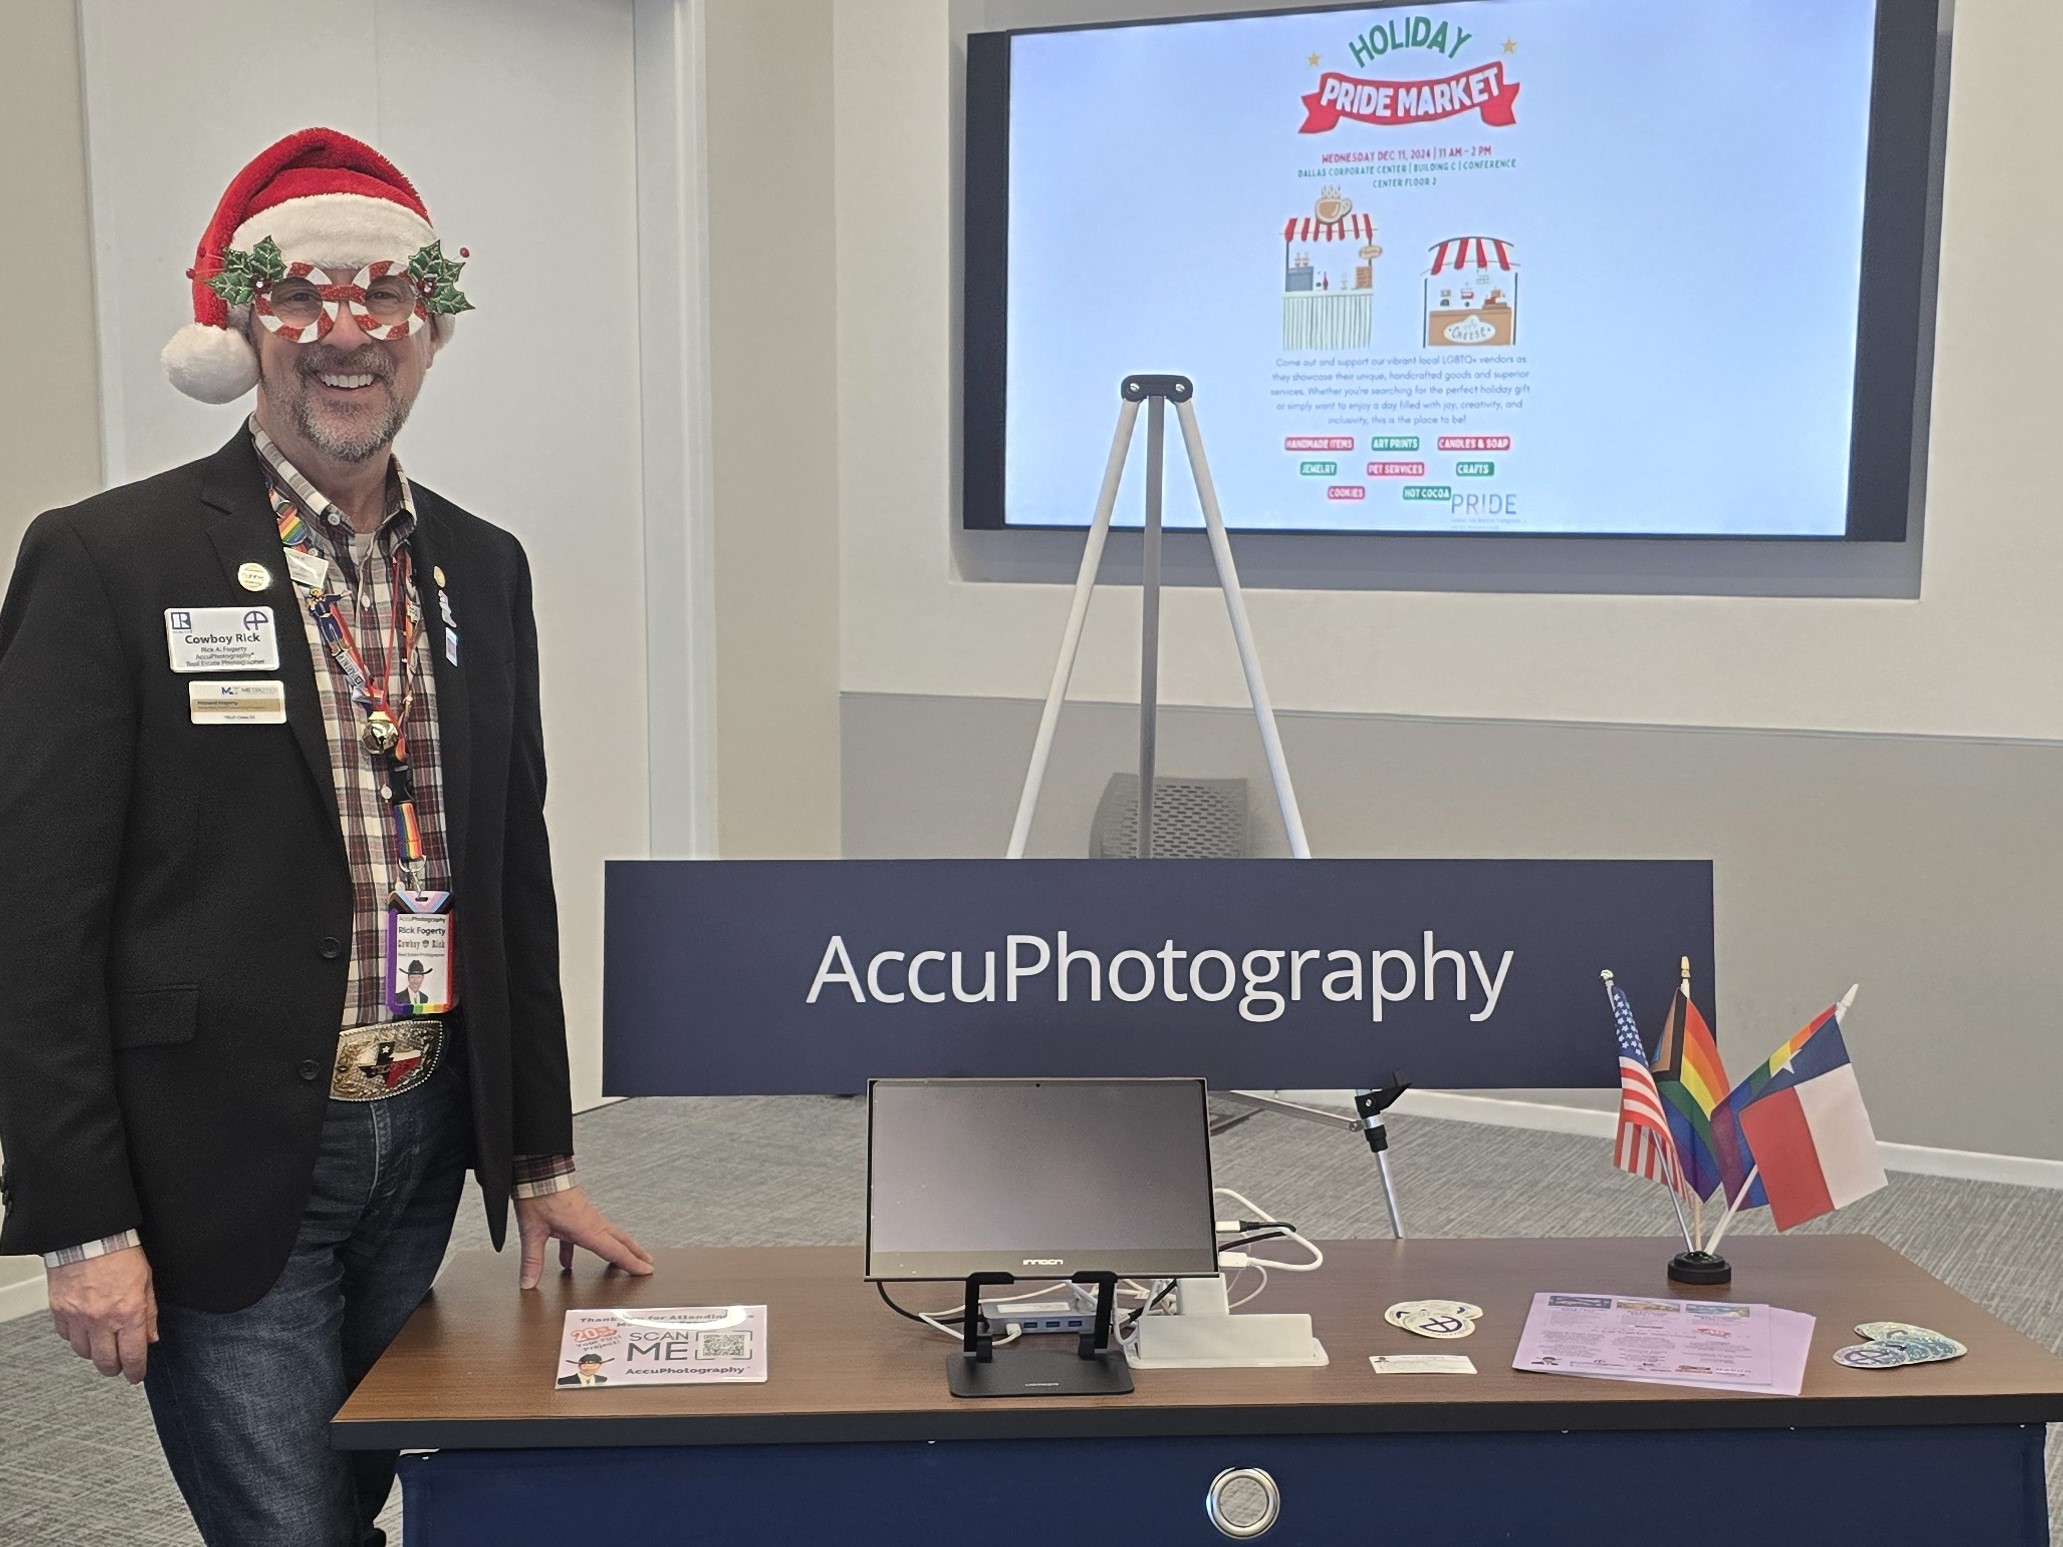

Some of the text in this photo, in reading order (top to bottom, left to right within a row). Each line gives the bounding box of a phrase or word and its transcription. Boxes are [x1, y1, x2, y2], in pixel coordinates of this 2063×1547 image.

[1349, 16, 1472, 68] HOLIDAY
[1320, 67, 1500, 117] PRIDE MARKET
[1322, 153, 1376, 164] WEDNESDAY
[1378, 152, 1395, 162] DEC
[1398, 151, 1408, 162] 11,
[1410, 150, 1431, 160] 2024
[1438, 148, 1447, 158] 11
[1449, 147, 1462, 158] AM
[1471, 146, 1476, 156] 2
[1478, 146, 1492, 156] PM
[1298, 168, 1327, 178] DALLAS
[1328, 166, 1374, 176] CORPORATE
[1376, 164, 1407, 174] CENTER
[1413, 162, 1450, 173] BUILDING
[1450, 162, 1456, 171] C
[1463, 158, 1517, 170] CONFERENCE
[1372, 178, 1402, 188] CENTER
[1404, 177, 1430, 188] FLOOR
[1452, 326, 1487, 340] CHEESE
[1276, 358, 1300, 367] Come
[1302, 359, 1316, 367] out
[1319, 358, 1335, 367] and
[1338, 358, 1369, 368] support
[1371, 358, 1385, 366] our
[1387, 356, 1416, 366] vibrant
[1419, 355, 1440, 365] local
[1480, 354, 1514, 364] vendors
[1272, 373, 1290, 383] they
[1292, 372, 1333, 380] showcase
[1336, 372, 1354, 380] their
[1389, 370, 1442, 380] handcrafted
[1445, 370, 1471, 381] goods
[1474, 370, 1492, 378] and
[1494, 370, 1529, 380] superior
[1308, 387, 1342, 396] Whether
[1344, 386, 1369, 397] you're
[1371, 386, 1412, 397] searching
[1415, 386, 1426, 394] for
[1430, 385, 1444, 394] the
[1446, 384, 1478, 396] perfect
[1480, 384, 1512, 395] holiday
[1514, 384, 1530, 396] gift
[1288, 402, 1312, 412] simply
[1338, 402, 1346, 410] to
[1348, 402, 1371, 412] enjoy
[1382, 401, 1398, 412] day
[1399, 400, 1420, 410] filled
[1423, 400, 1440, 410] with
[1506, 399, 1523, 408] and
[1371, 414, 1386, 424] this
[1388, 416, 1395, 424] is
[1398, 414, 1412, 424] the
[1414, 415, 1438, 426] place
[1440, 415, 1450, 424] to
[1286, 438, 1353, 450] HANDMADE ITEMS
[1373, 438, 1418, 449] ART PRINTS
[1439, 438, 1509, 449] CANDLES & SOAP
[1302, 464, 1336, 474] JEWELRY
[1368, 464, 1423, 474] PET SERVICES
[1458, 464, 1490, 474] CRAFTS
[1329, 488, 1364, 498] COOKIES
[1404, 488, 1450, 498] HOT COCOA
[185, 633, 260, 645] Cowboy Rick
[398, 926, 446, 936] Rick Fogerty
[806, 930, 1515, 1023] AccuPhotography
[629, 1331, 690, 1342] SCAN
[626, 1342, 688, 1362] ME
[625, 1366, 745, 1376] AccuPhotography
